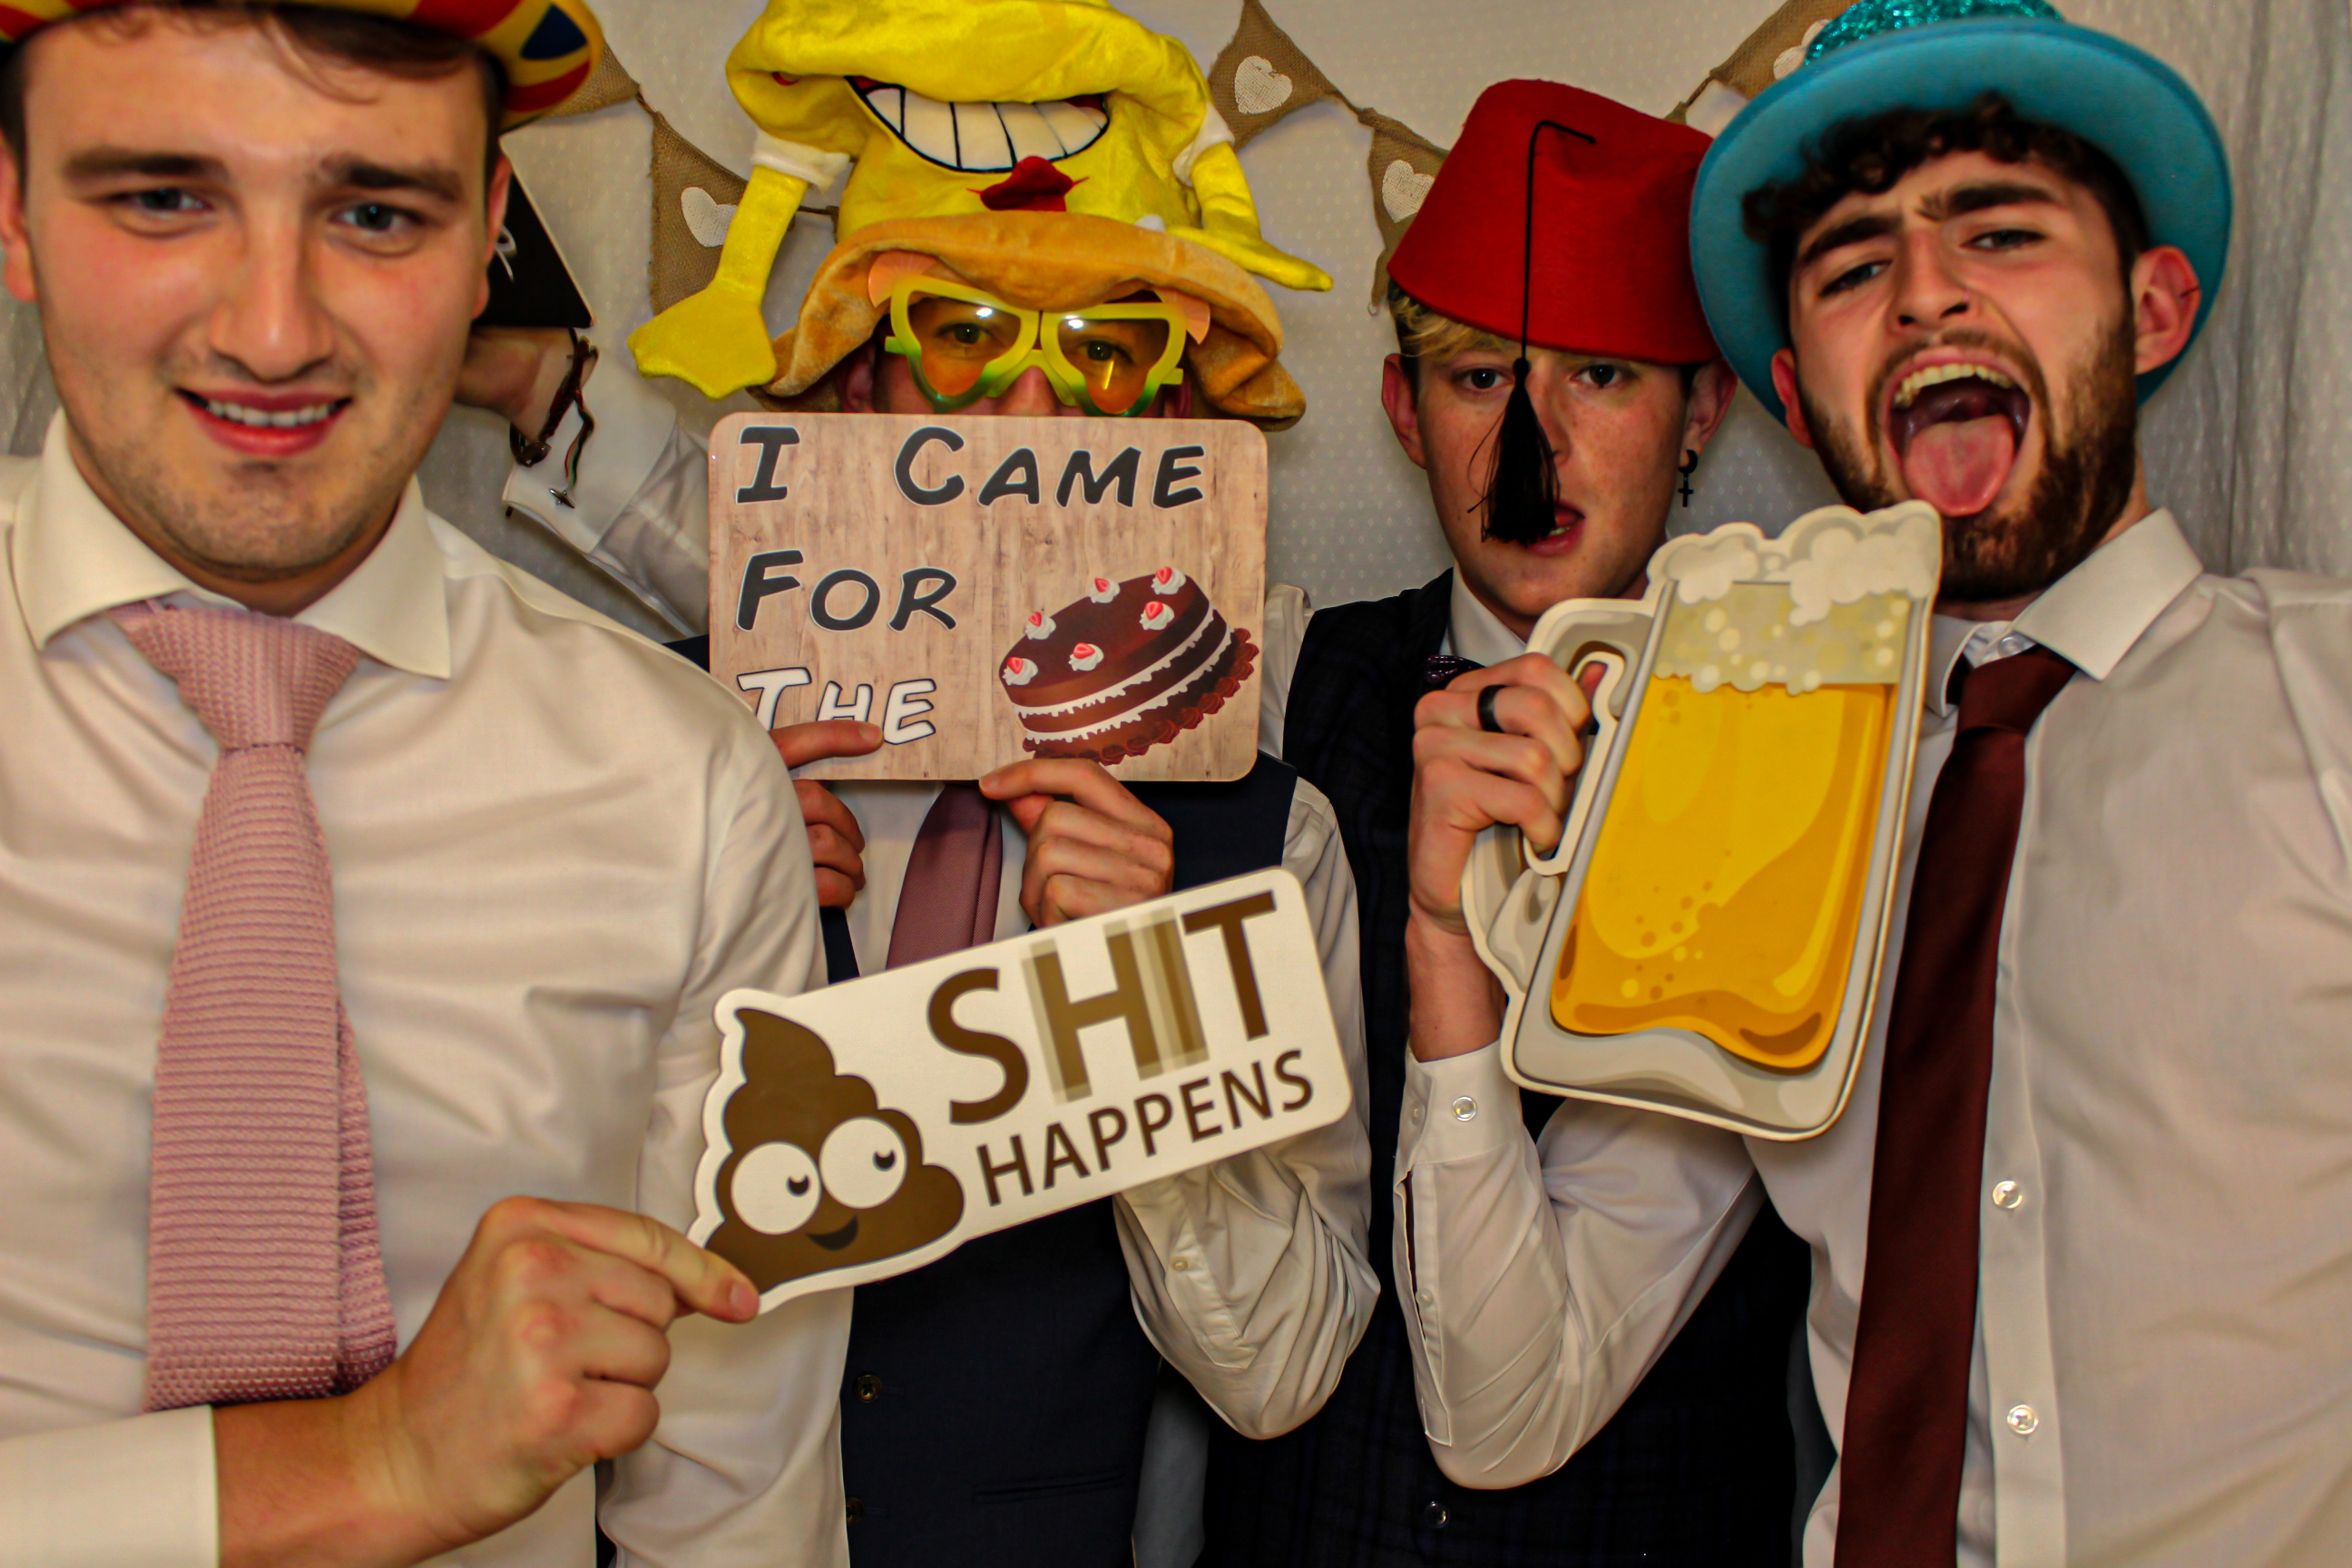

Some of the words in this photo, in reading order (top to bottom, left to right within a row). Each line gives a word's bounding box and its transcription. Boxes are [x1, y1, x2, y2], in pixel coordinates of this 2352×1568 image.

[736, 426, 800, 505] I
[894, 426, 1205, 509] CAME
[736, 549, 958, 632] FOR
[736, 667, 937, 745] THE
[926, 890, 1278, 1125] SHIT
[976, 1050, 1314, 1208] HAPPENS
